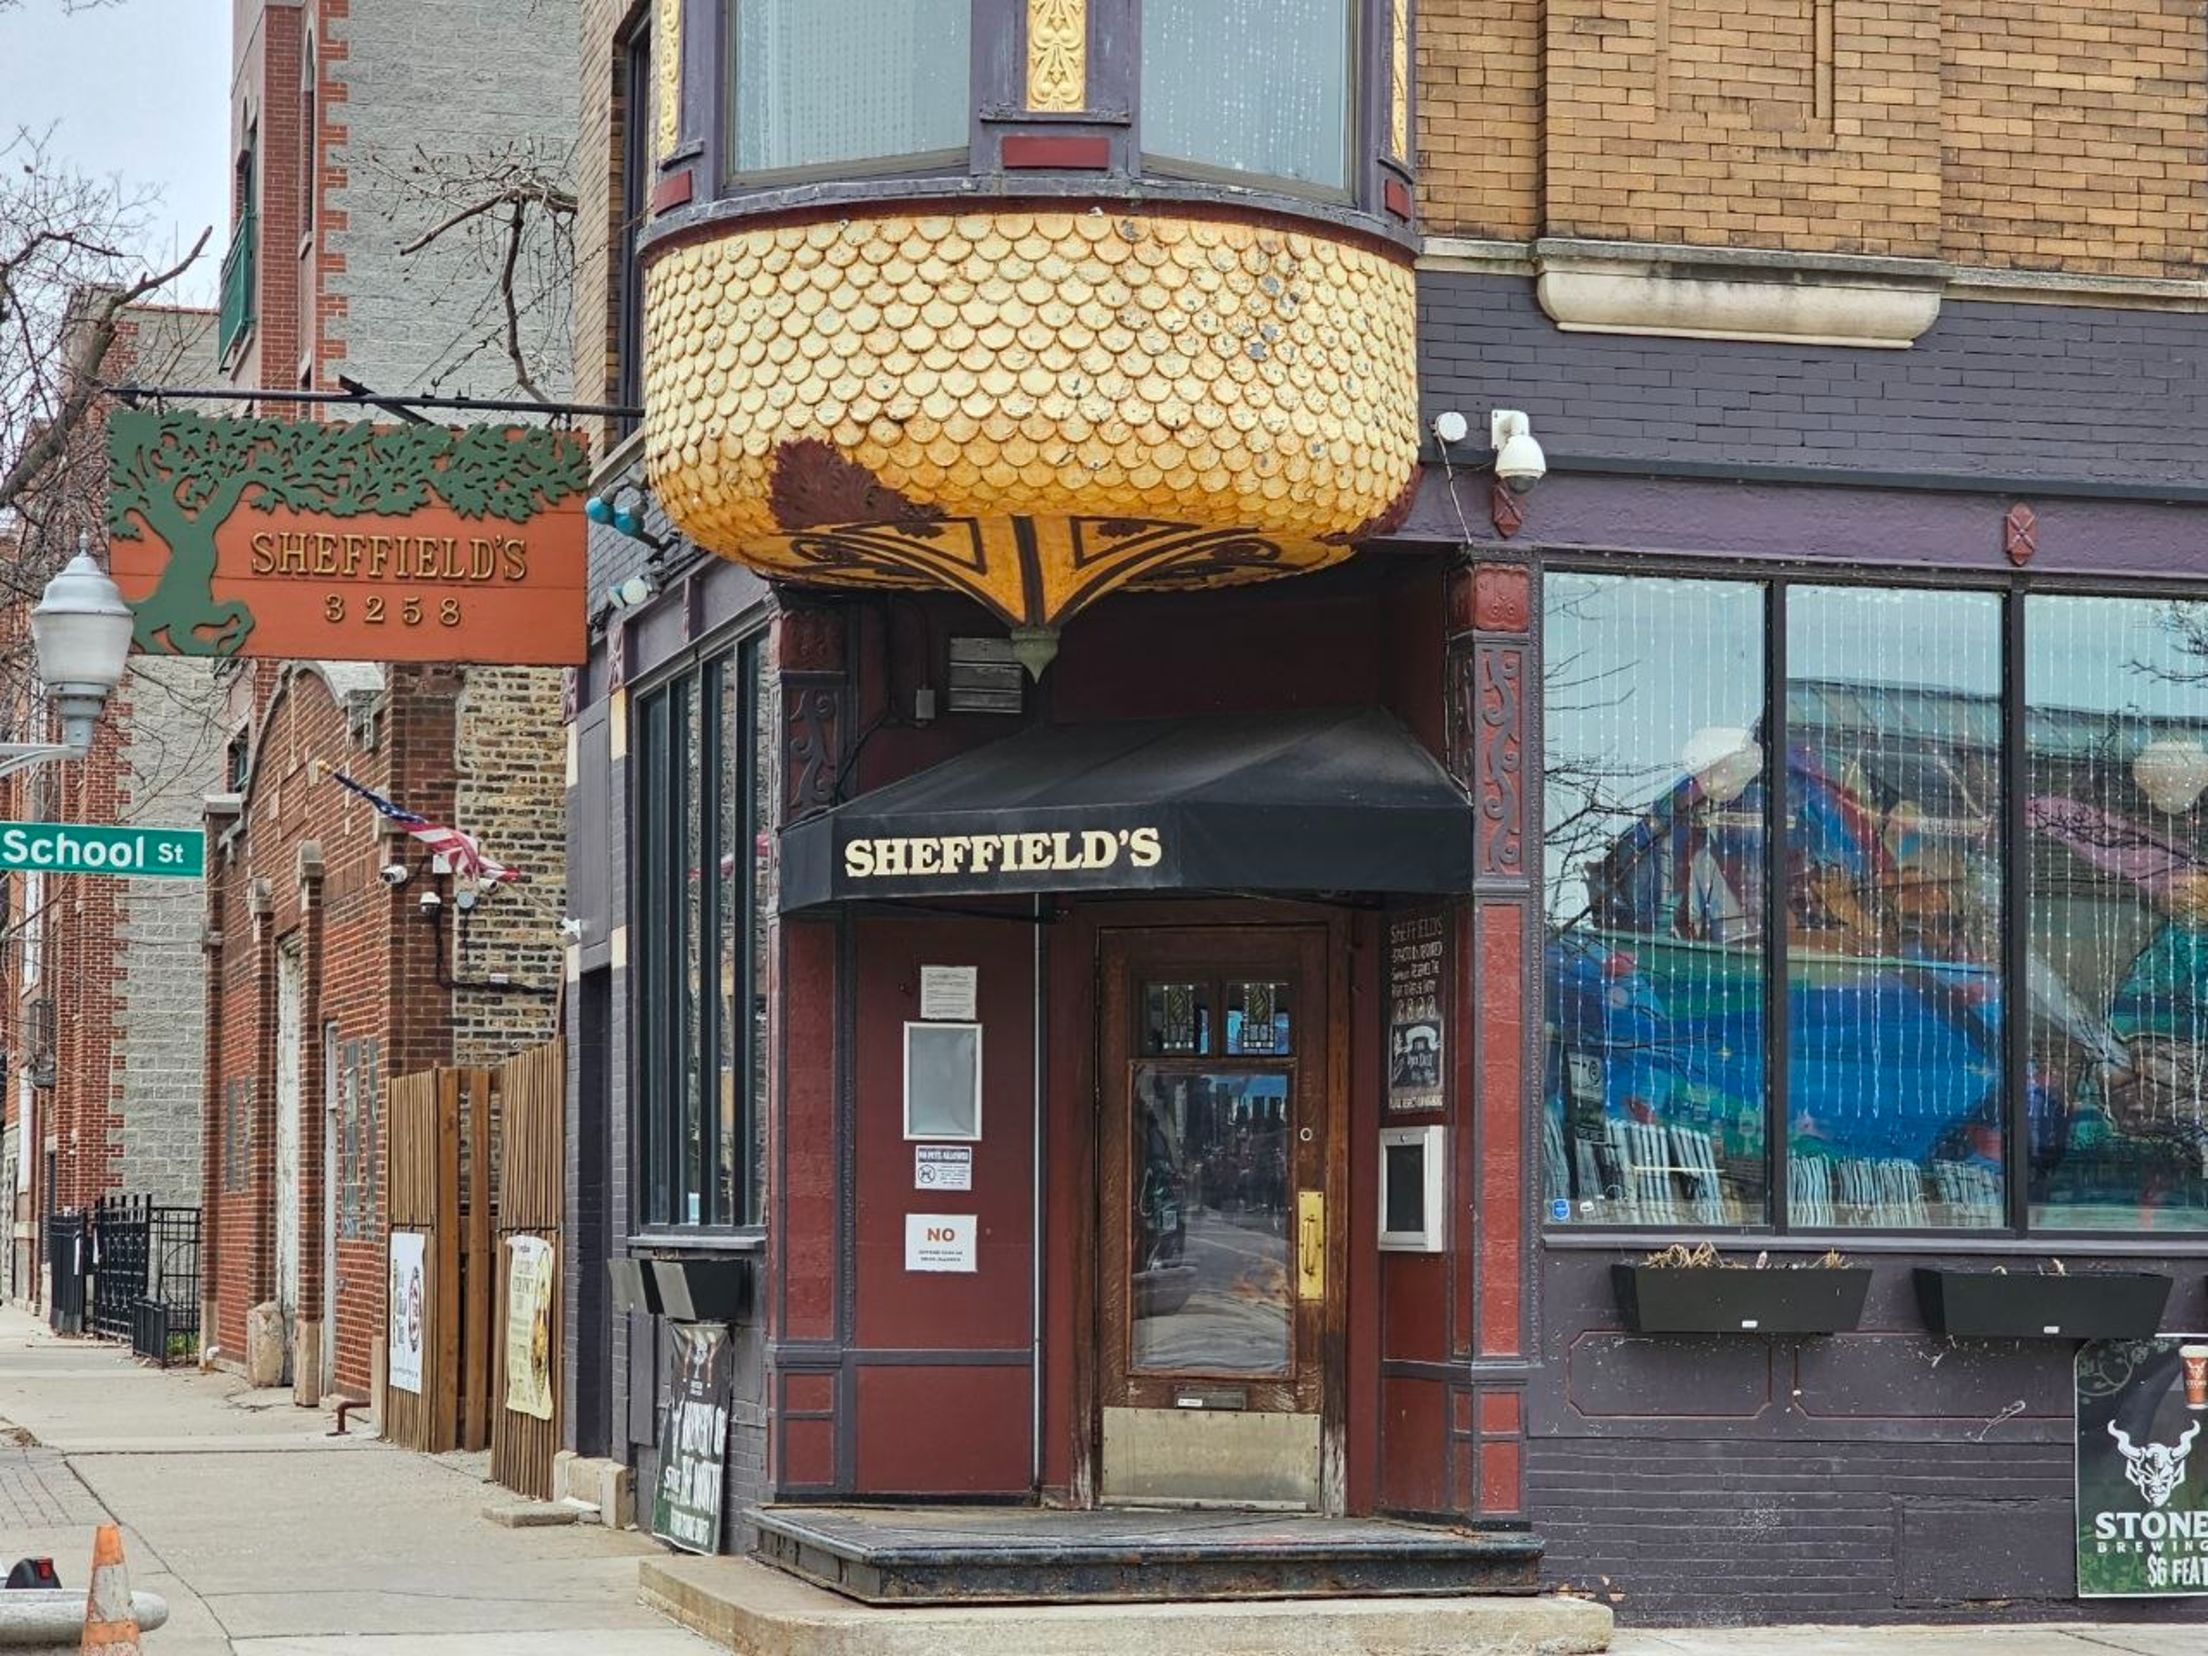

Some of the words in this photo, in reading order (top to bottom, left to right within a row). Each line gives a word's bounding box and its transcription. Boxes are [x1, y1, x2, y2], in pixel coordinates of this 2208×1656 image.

[251, 531, 527, 581] SHEFFIELD'S
[1, 829, 144, 868] School
[157, 843, 184, 863] St
[844, 828, 1162, 877] SHEFFIELD'S
[927, 1228, 955, 1242] NO
[2095, 1510, 2208, 1540] STONE
[2097, 1540, 2208, 1554] BREWING
[2147, 1553, 2168, 1588] $6
